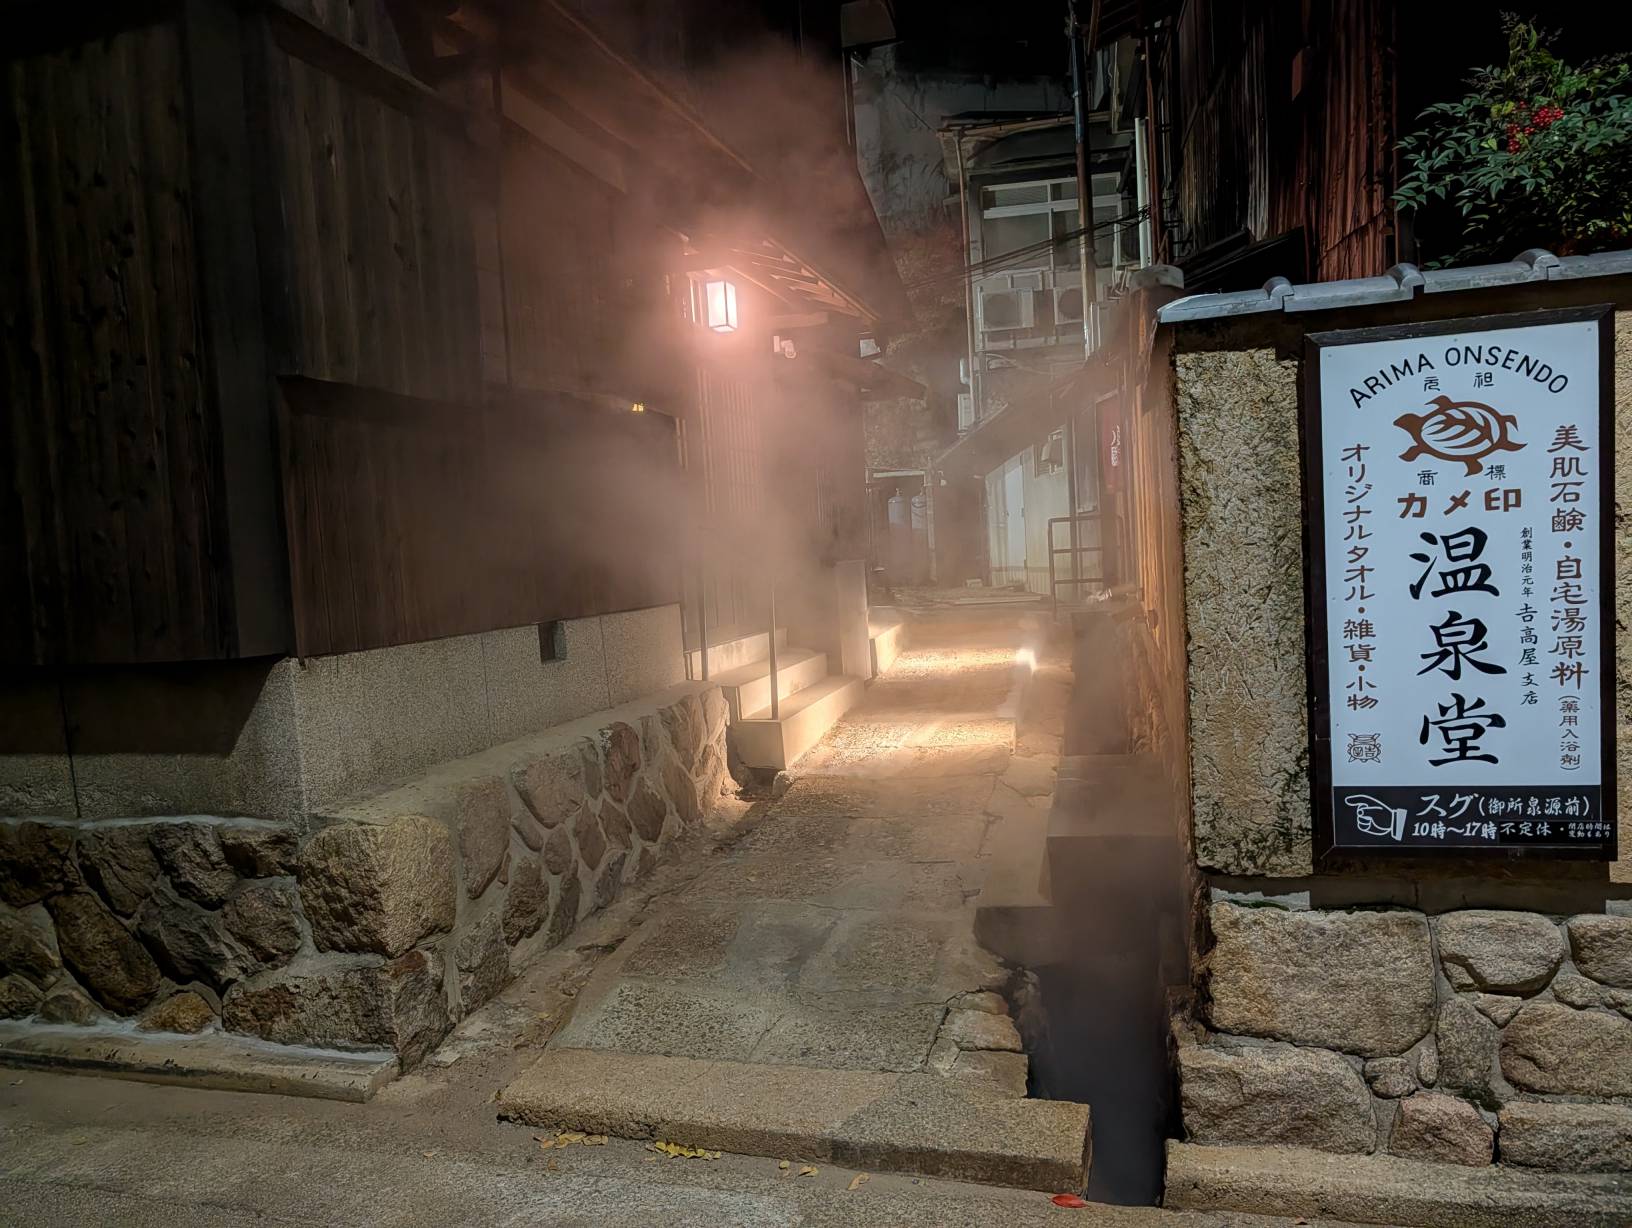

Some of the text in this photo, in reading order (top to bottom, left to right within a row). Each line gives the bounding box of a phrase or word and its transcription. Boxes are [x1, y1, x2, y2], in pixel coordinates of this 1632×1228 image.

[1350, 345, 1569, 408] ARIMA ONSENDO
[1341, 443, 1379, 711] オリジナルタオル・雑貨・小物
[1397, 488, 1522, 519] カメ印
[1408, 526, 1508, 767] 温泉堂
